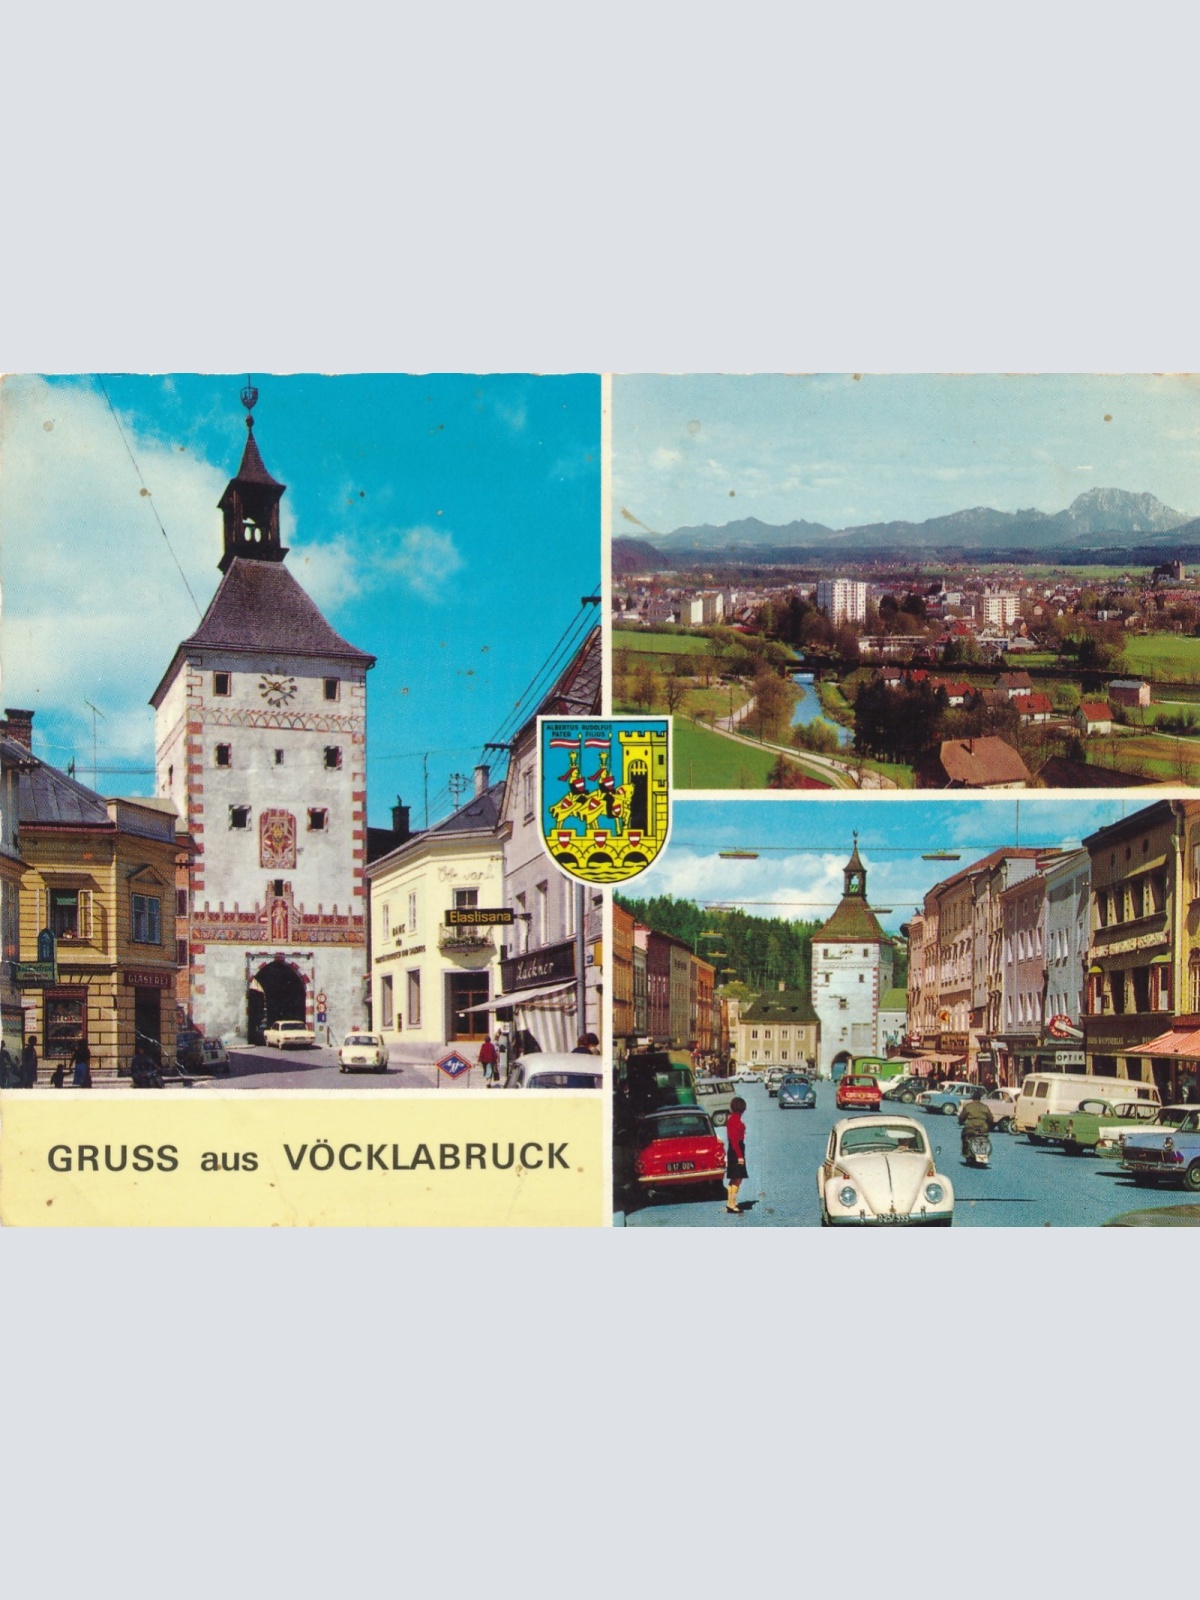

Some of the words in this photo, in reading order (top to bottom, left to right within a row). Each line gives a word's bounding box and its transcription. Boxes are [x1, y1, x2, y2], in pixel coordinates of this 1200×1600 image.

[449, 910, 512, 923] Elastisana
[128, 974, 168, 985] GLASEREI
[1056, 1054, 1083, 1062] OPTIK
[47, 1144, 179, 1173] GRUSS
[200, 1152, 259, 1172] aus
[283, 1139, 571, 1171] VÖCKLABRUCK
